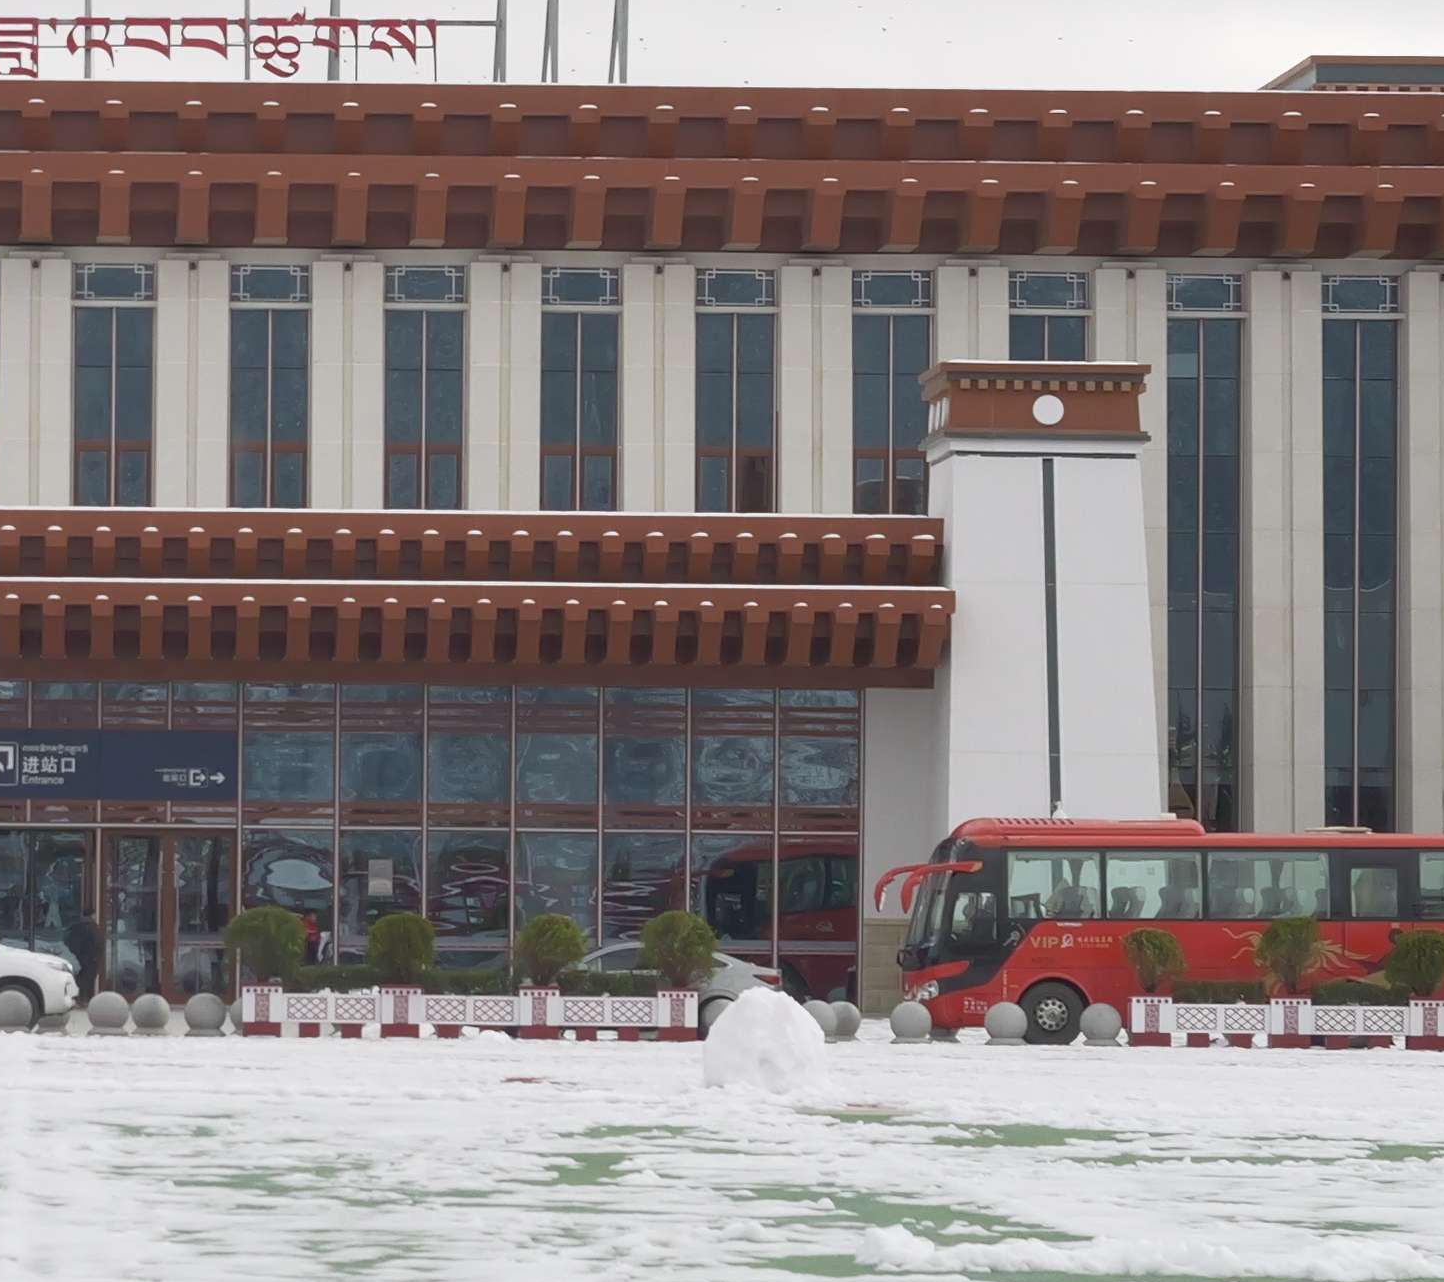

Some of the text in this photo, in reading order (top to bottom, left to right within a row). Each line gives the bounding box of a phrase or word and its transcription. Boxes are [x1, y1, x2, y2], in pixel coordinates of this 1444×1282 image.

[22, 756, 76, 773] 进站口
[21, 774, 64, 785] Entrance
[1030, 936, 1060, 949] VIP
